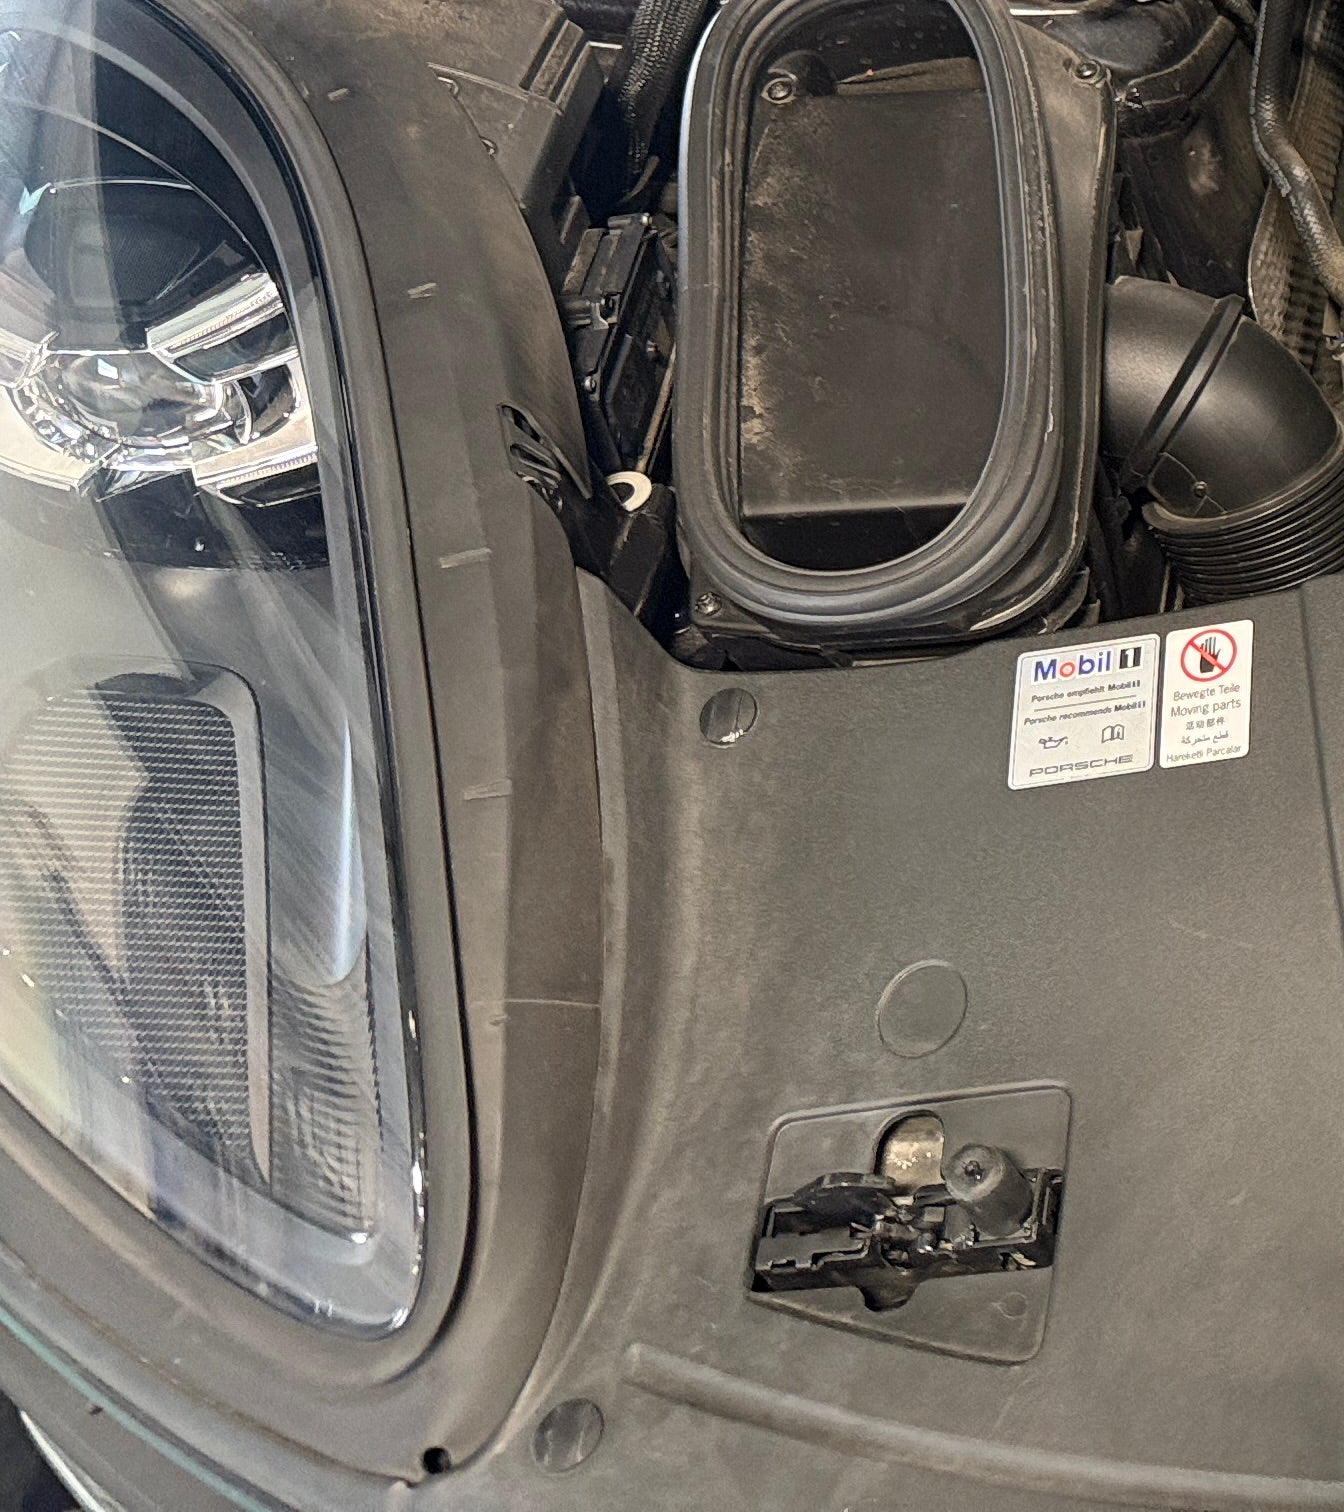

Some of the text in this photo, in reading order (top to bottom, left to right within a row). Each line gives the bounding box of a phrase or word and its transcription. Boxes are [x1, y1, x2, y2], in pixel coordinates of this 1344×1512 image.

[1034, 651, 1111, 682] Mobil
[1031, 691, 1065, 703] Porsche
[1067, 686, 1105, 697] empfiehlt
[1108, 680, 1131, 691] Mobil
[1173, 683, 1241, 702] Bewegte Teile
[1024, 715, 1057, 726] Porsche
[1059, 707, 1112, 720] recommends
[1114, 702, 1137, 712] Mobil
[1171, 698, 1241, 717] Moving parts
[1029, 754, 1134, 777] PORSCHE
